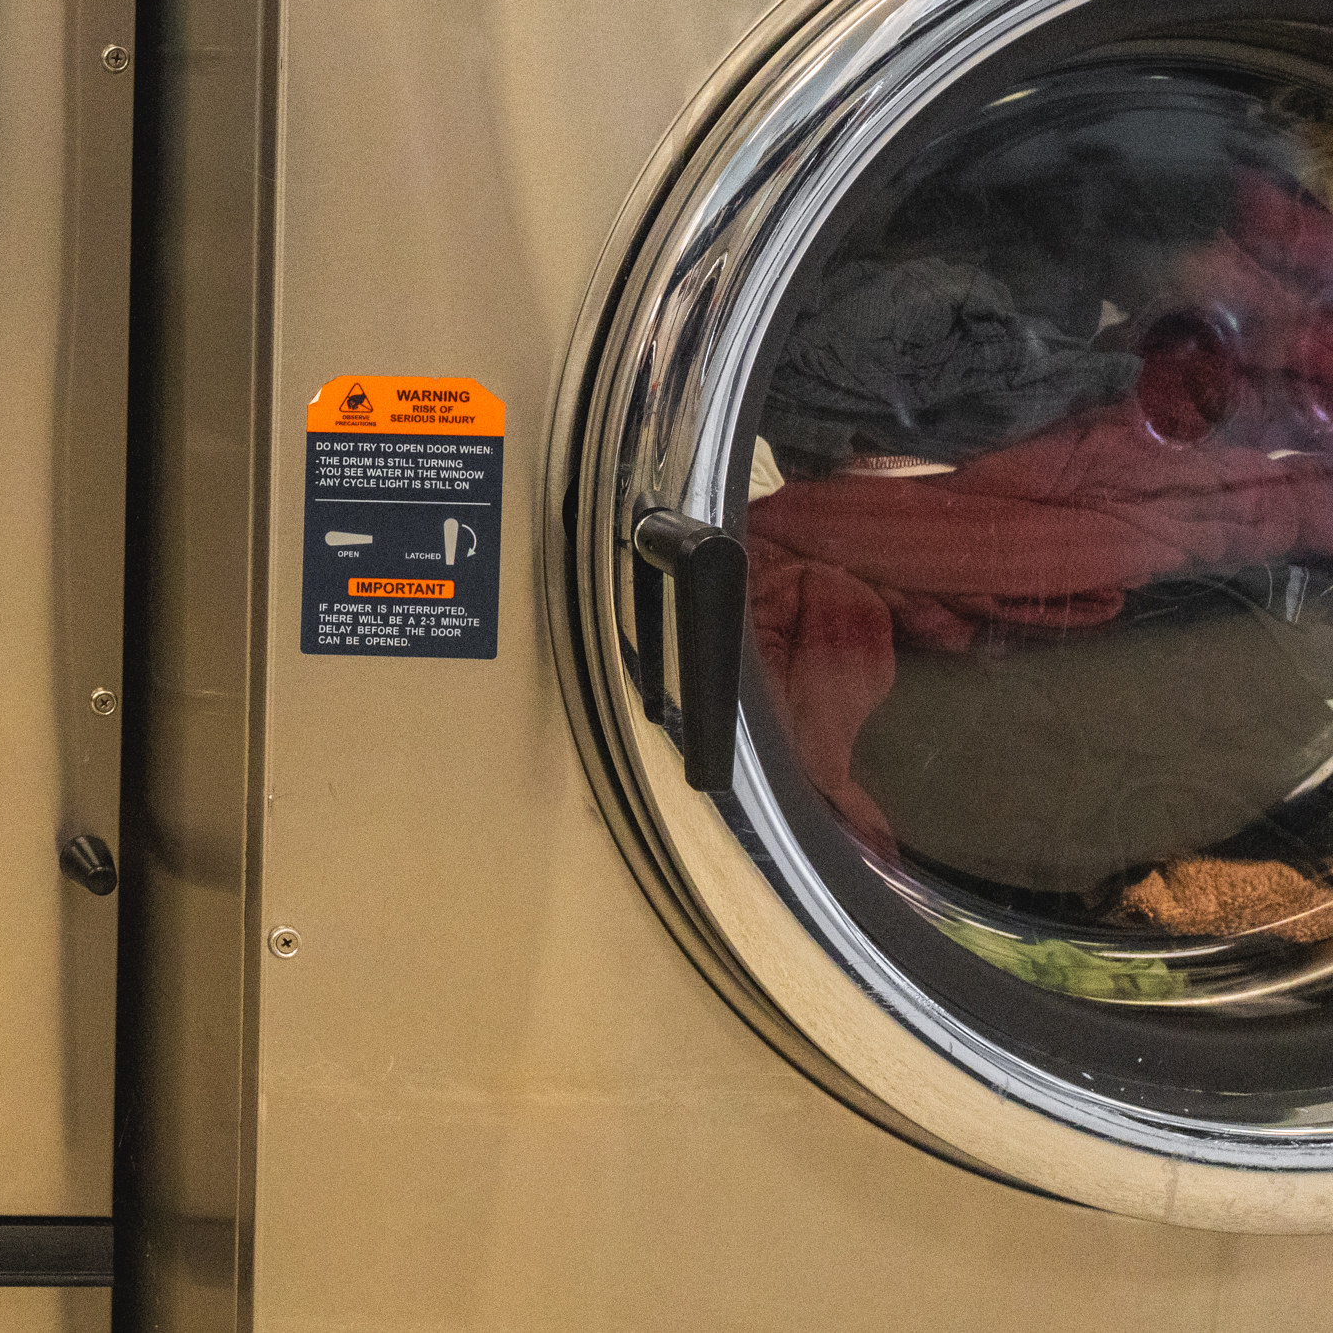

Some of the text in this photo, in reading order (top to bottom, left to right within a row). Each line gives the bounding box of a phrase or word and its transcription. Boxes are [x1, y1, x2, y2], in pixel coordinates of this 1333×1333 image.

[396, 390, 470, 403] WARNING
[412, 405, 454, 413] RISK OF
[390, 413, 476, 424] SERIOUS INJURY
[337, 550, 360, 558] OPEN
[405, 552, 441, 560] LATCHED
[356, 581, 446, 596] IMPORTANT
